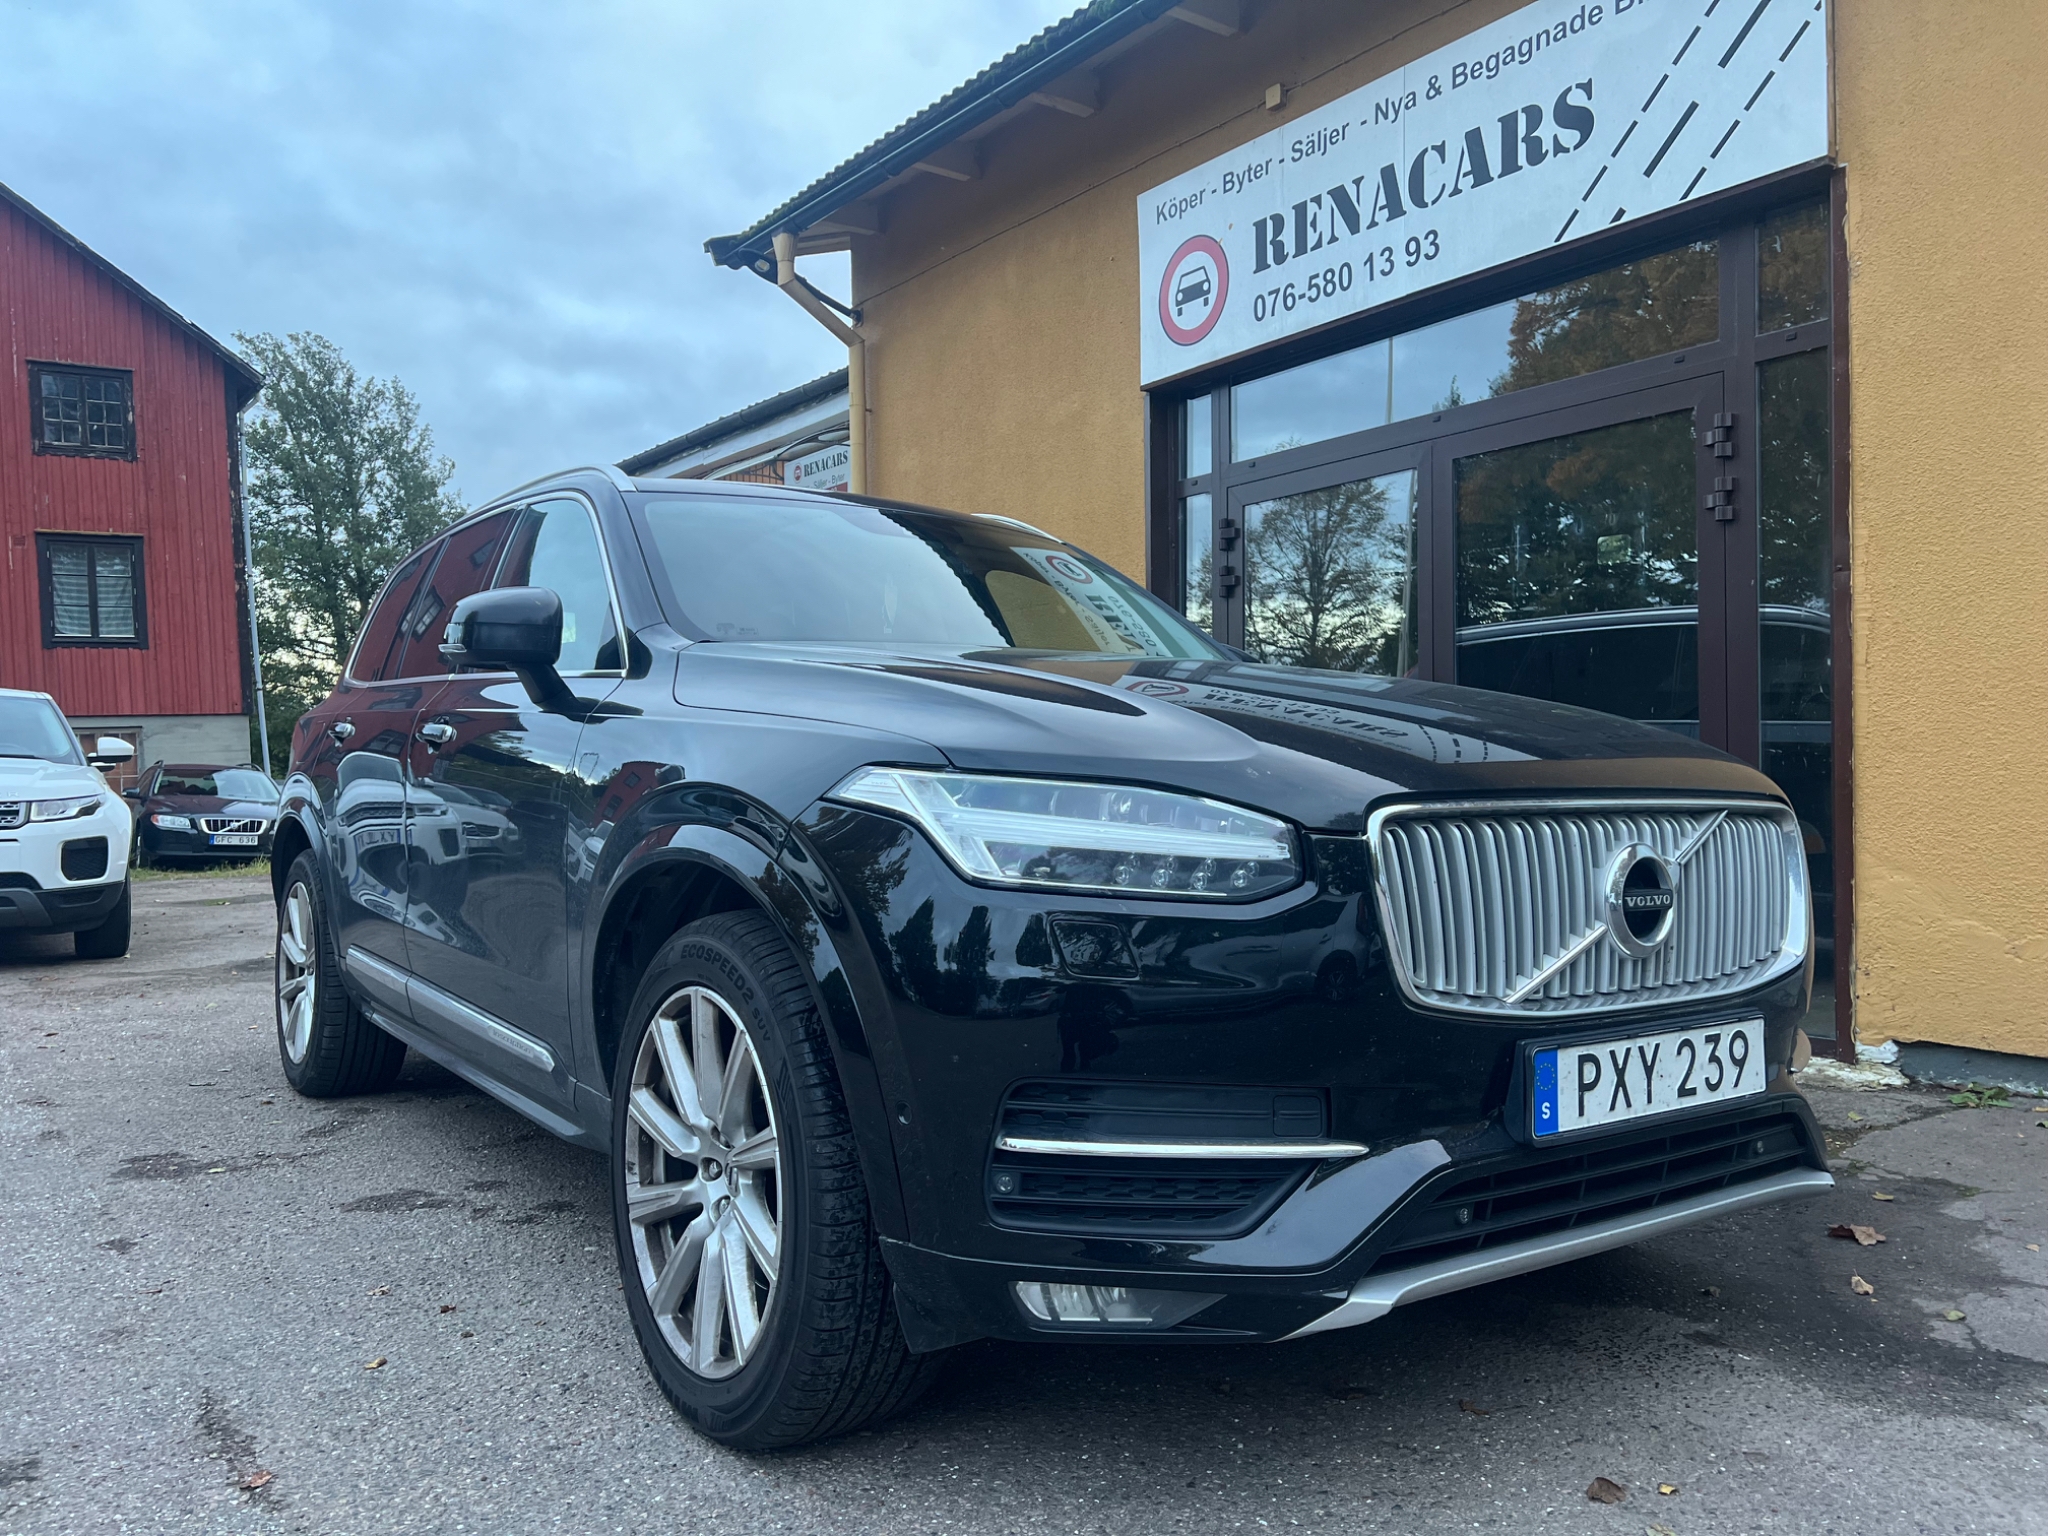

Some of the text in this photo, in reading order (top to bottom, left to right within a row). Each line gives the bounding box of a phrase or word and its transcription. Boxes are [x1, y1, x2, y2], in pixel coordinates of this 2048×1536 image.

[1156, 188, 1207, 225] Köper
[1223, 158, 1273, 195] Byter
[1291, 122, 1350, 163] Säljer
[1374, 91, 1417, 125] Nya
[1425, 74, 1443, 100] &
[1451, 4, 1604, 90] Begagnade
[1253, 77, 1595, 275] RENACARS
[1253, 229, 1441, 322] 076-580 13 93
[803, 450, 848, 478] RENACARS
[215, 836, 256, 844] GFC 636
[1624, 894, 1671, 908] VOLVO
[680, 943, 755, 1005] ECOSPEED2
[752, 1006, 771, 1041] SUV
[1541, 1101, 1551, 1119] S
[1577, 1029, 1749, 1117] PXY 239
